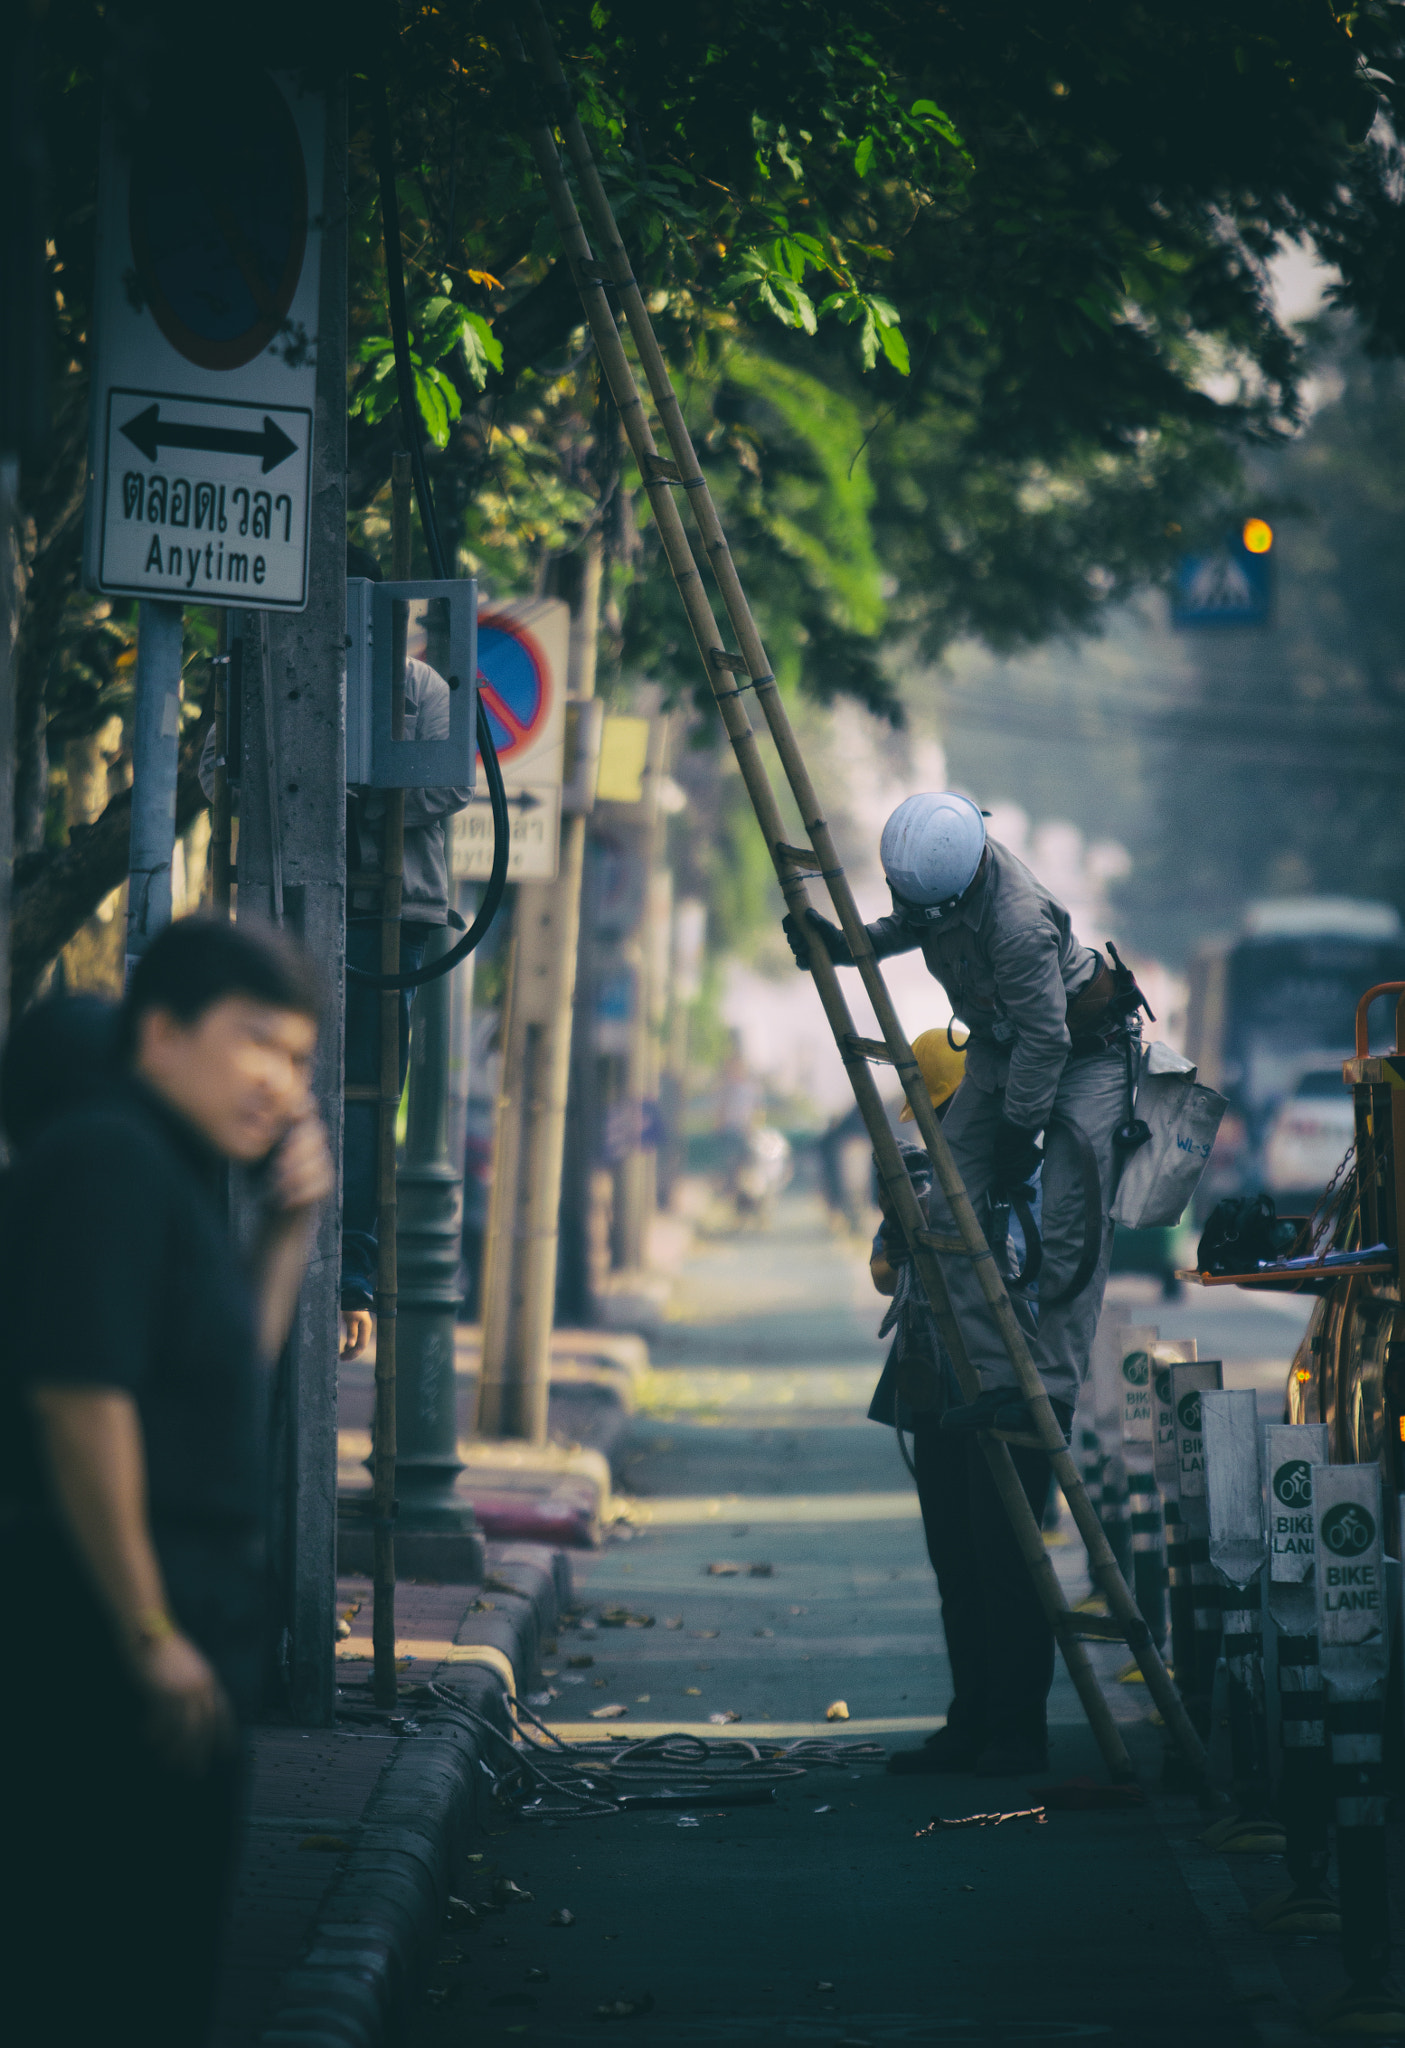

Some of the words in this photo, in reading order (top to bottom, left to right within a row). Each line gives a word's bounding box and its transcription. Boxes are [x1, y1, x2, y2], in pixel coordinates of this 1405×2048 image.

[122, 470, 293, 543] ตลอดเวลา
[145, 533, 267, 589] Anytime
[1126, 1392, 1149, 1405] BIK
[1125, 1408, 1151, 1421] LAN
[1160, 1412, 1174, 1427] BI
[1158, 1429, 1175, 1444] LA
[1274, 1538, 1315, 1554] LAN
[1327, 1565, 1375, 1586] BIKE
[1325, 1590, 1380, 1612] LANE
